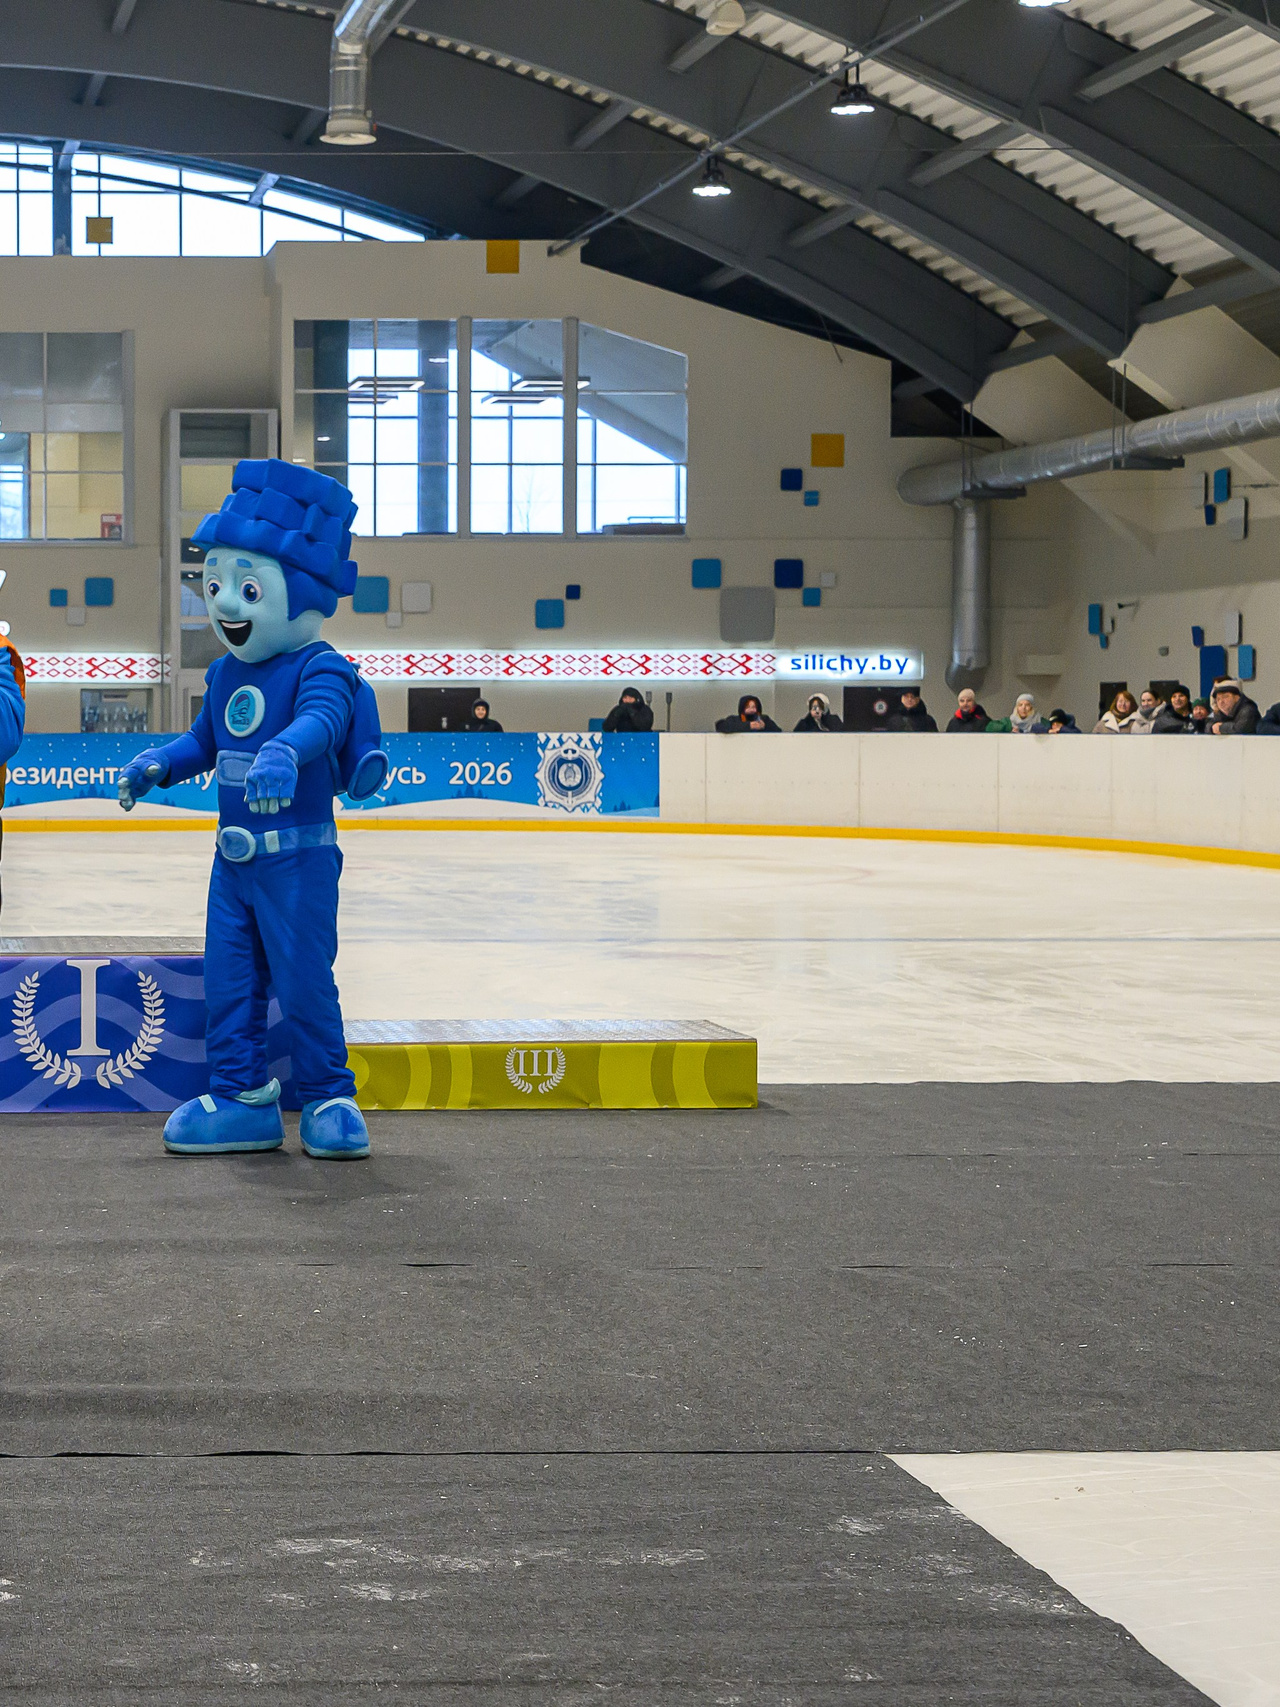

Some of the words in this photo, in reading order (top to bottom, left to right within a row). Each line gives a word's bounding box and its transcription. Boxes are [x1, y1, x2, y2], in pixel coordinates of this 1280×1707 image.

[790, 654, 909, 675] silichy.by
[5, 766, 124, 790] езидент
[448, 761, 513, 786] 2026
[66, 959, 111, 1056] I
[516, 1049, 556, 1076] III
